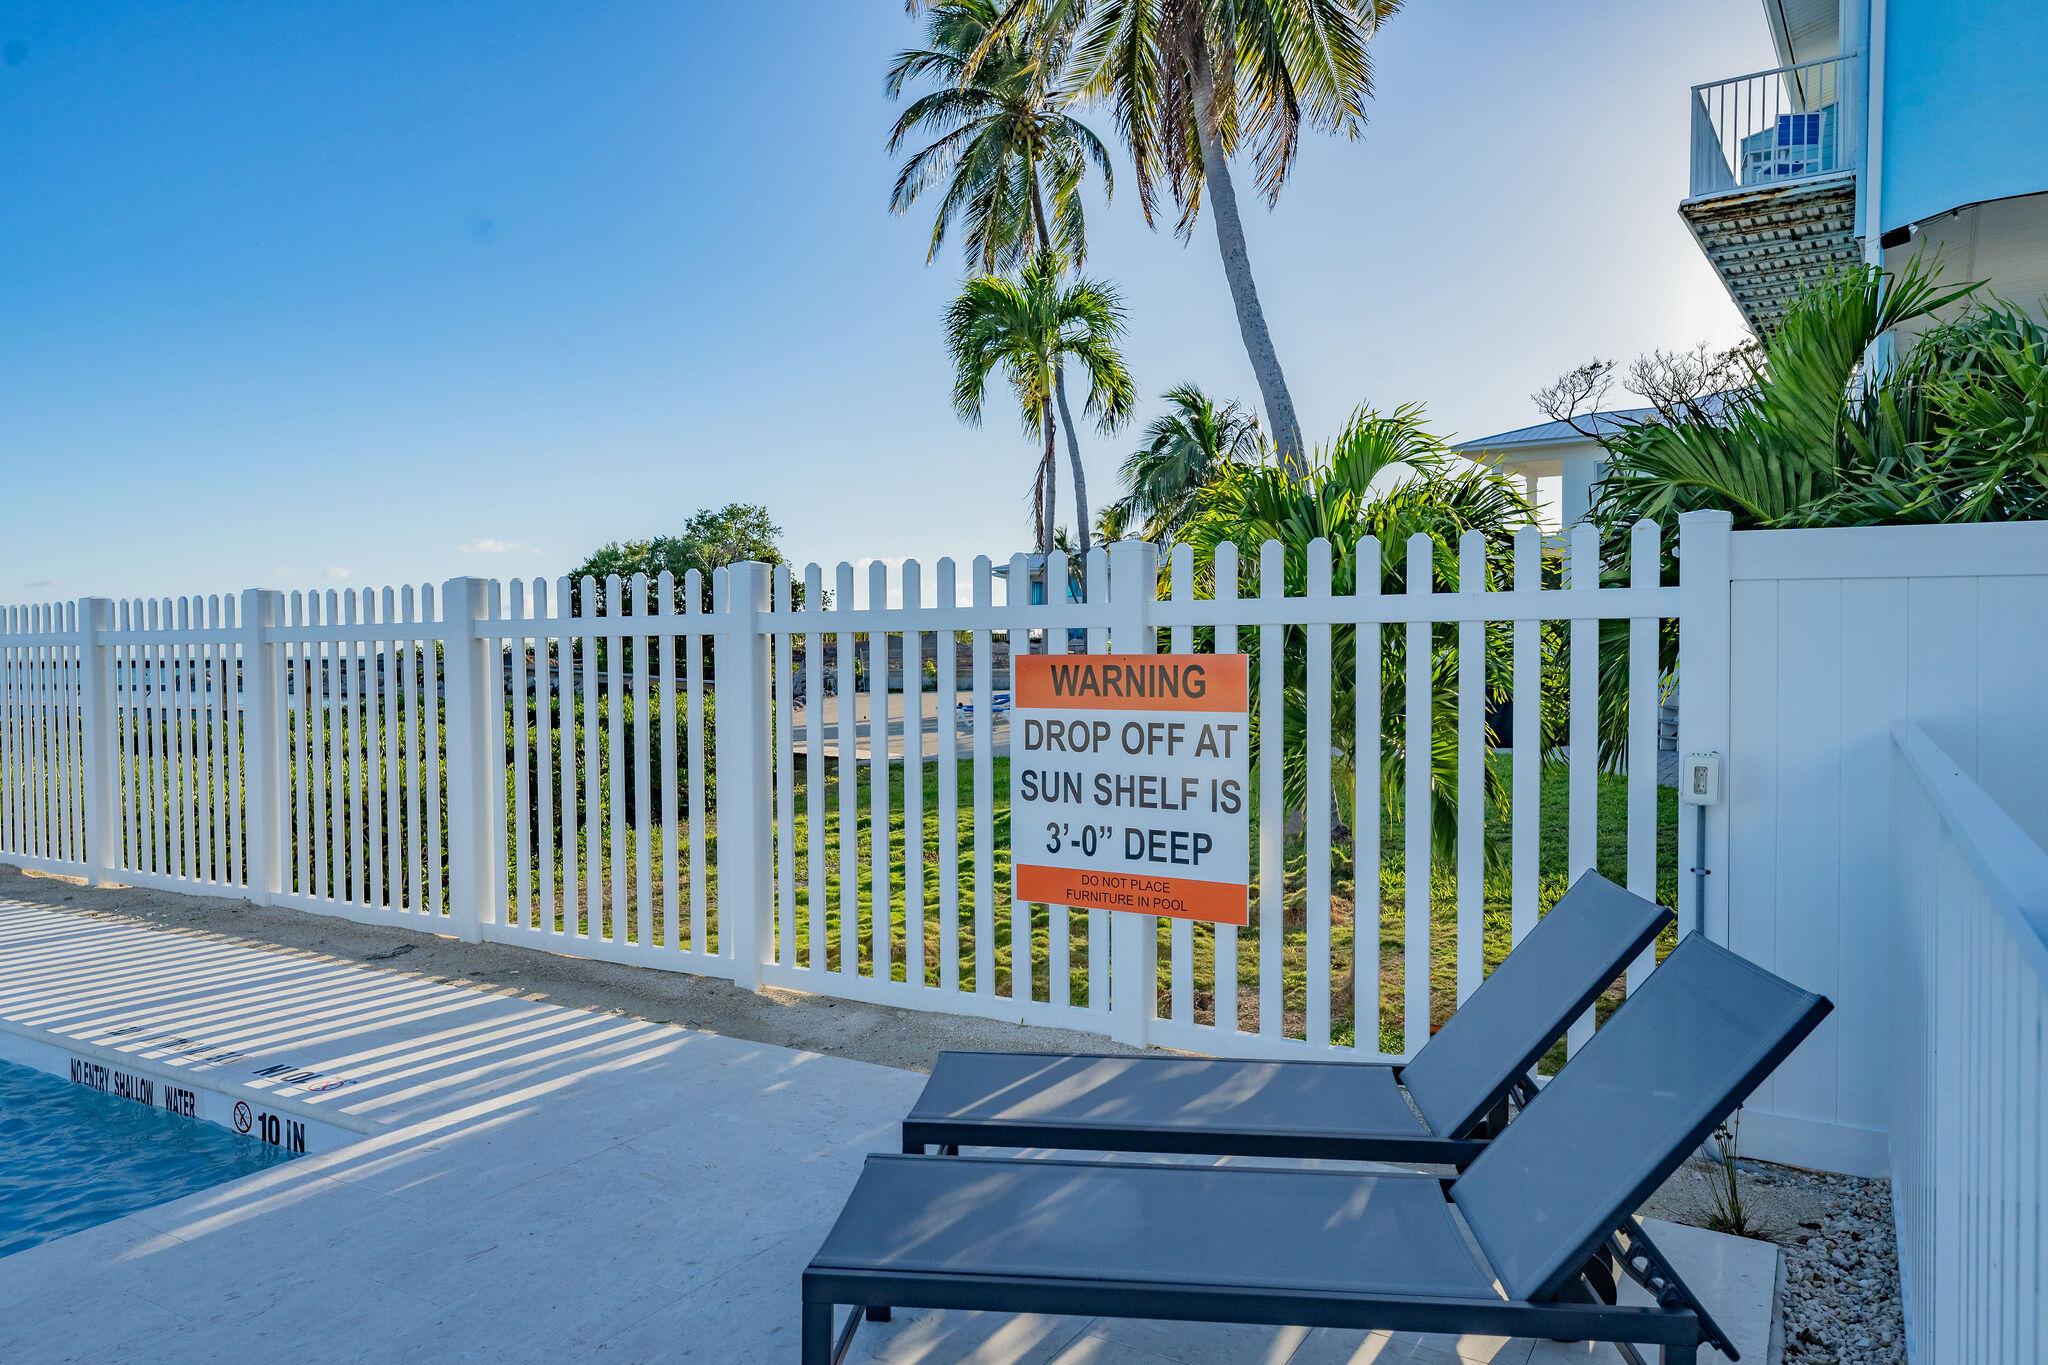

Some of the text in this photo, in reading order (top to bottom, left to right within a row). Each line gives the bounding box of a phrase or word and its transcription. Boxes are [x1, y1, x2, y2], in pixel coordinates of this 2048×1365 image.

[1050, 664, 1207, 699] WARNING
[1024, 719, 1239, 759] DROP OFF AT
[1020, 769, 1242, 814] SUN SHELF IS
[1124, 827, 1213, 866] DEEP
[1066, 888, 1188, 912] FURNITURE IN POOL
[1081, 874, 1170, 894] DO NOT PLACE
[70, 1058, 195, 1119] NO ENTRY SHALLOW WATER
[258, 1112, 305, 1153] 10 IN
